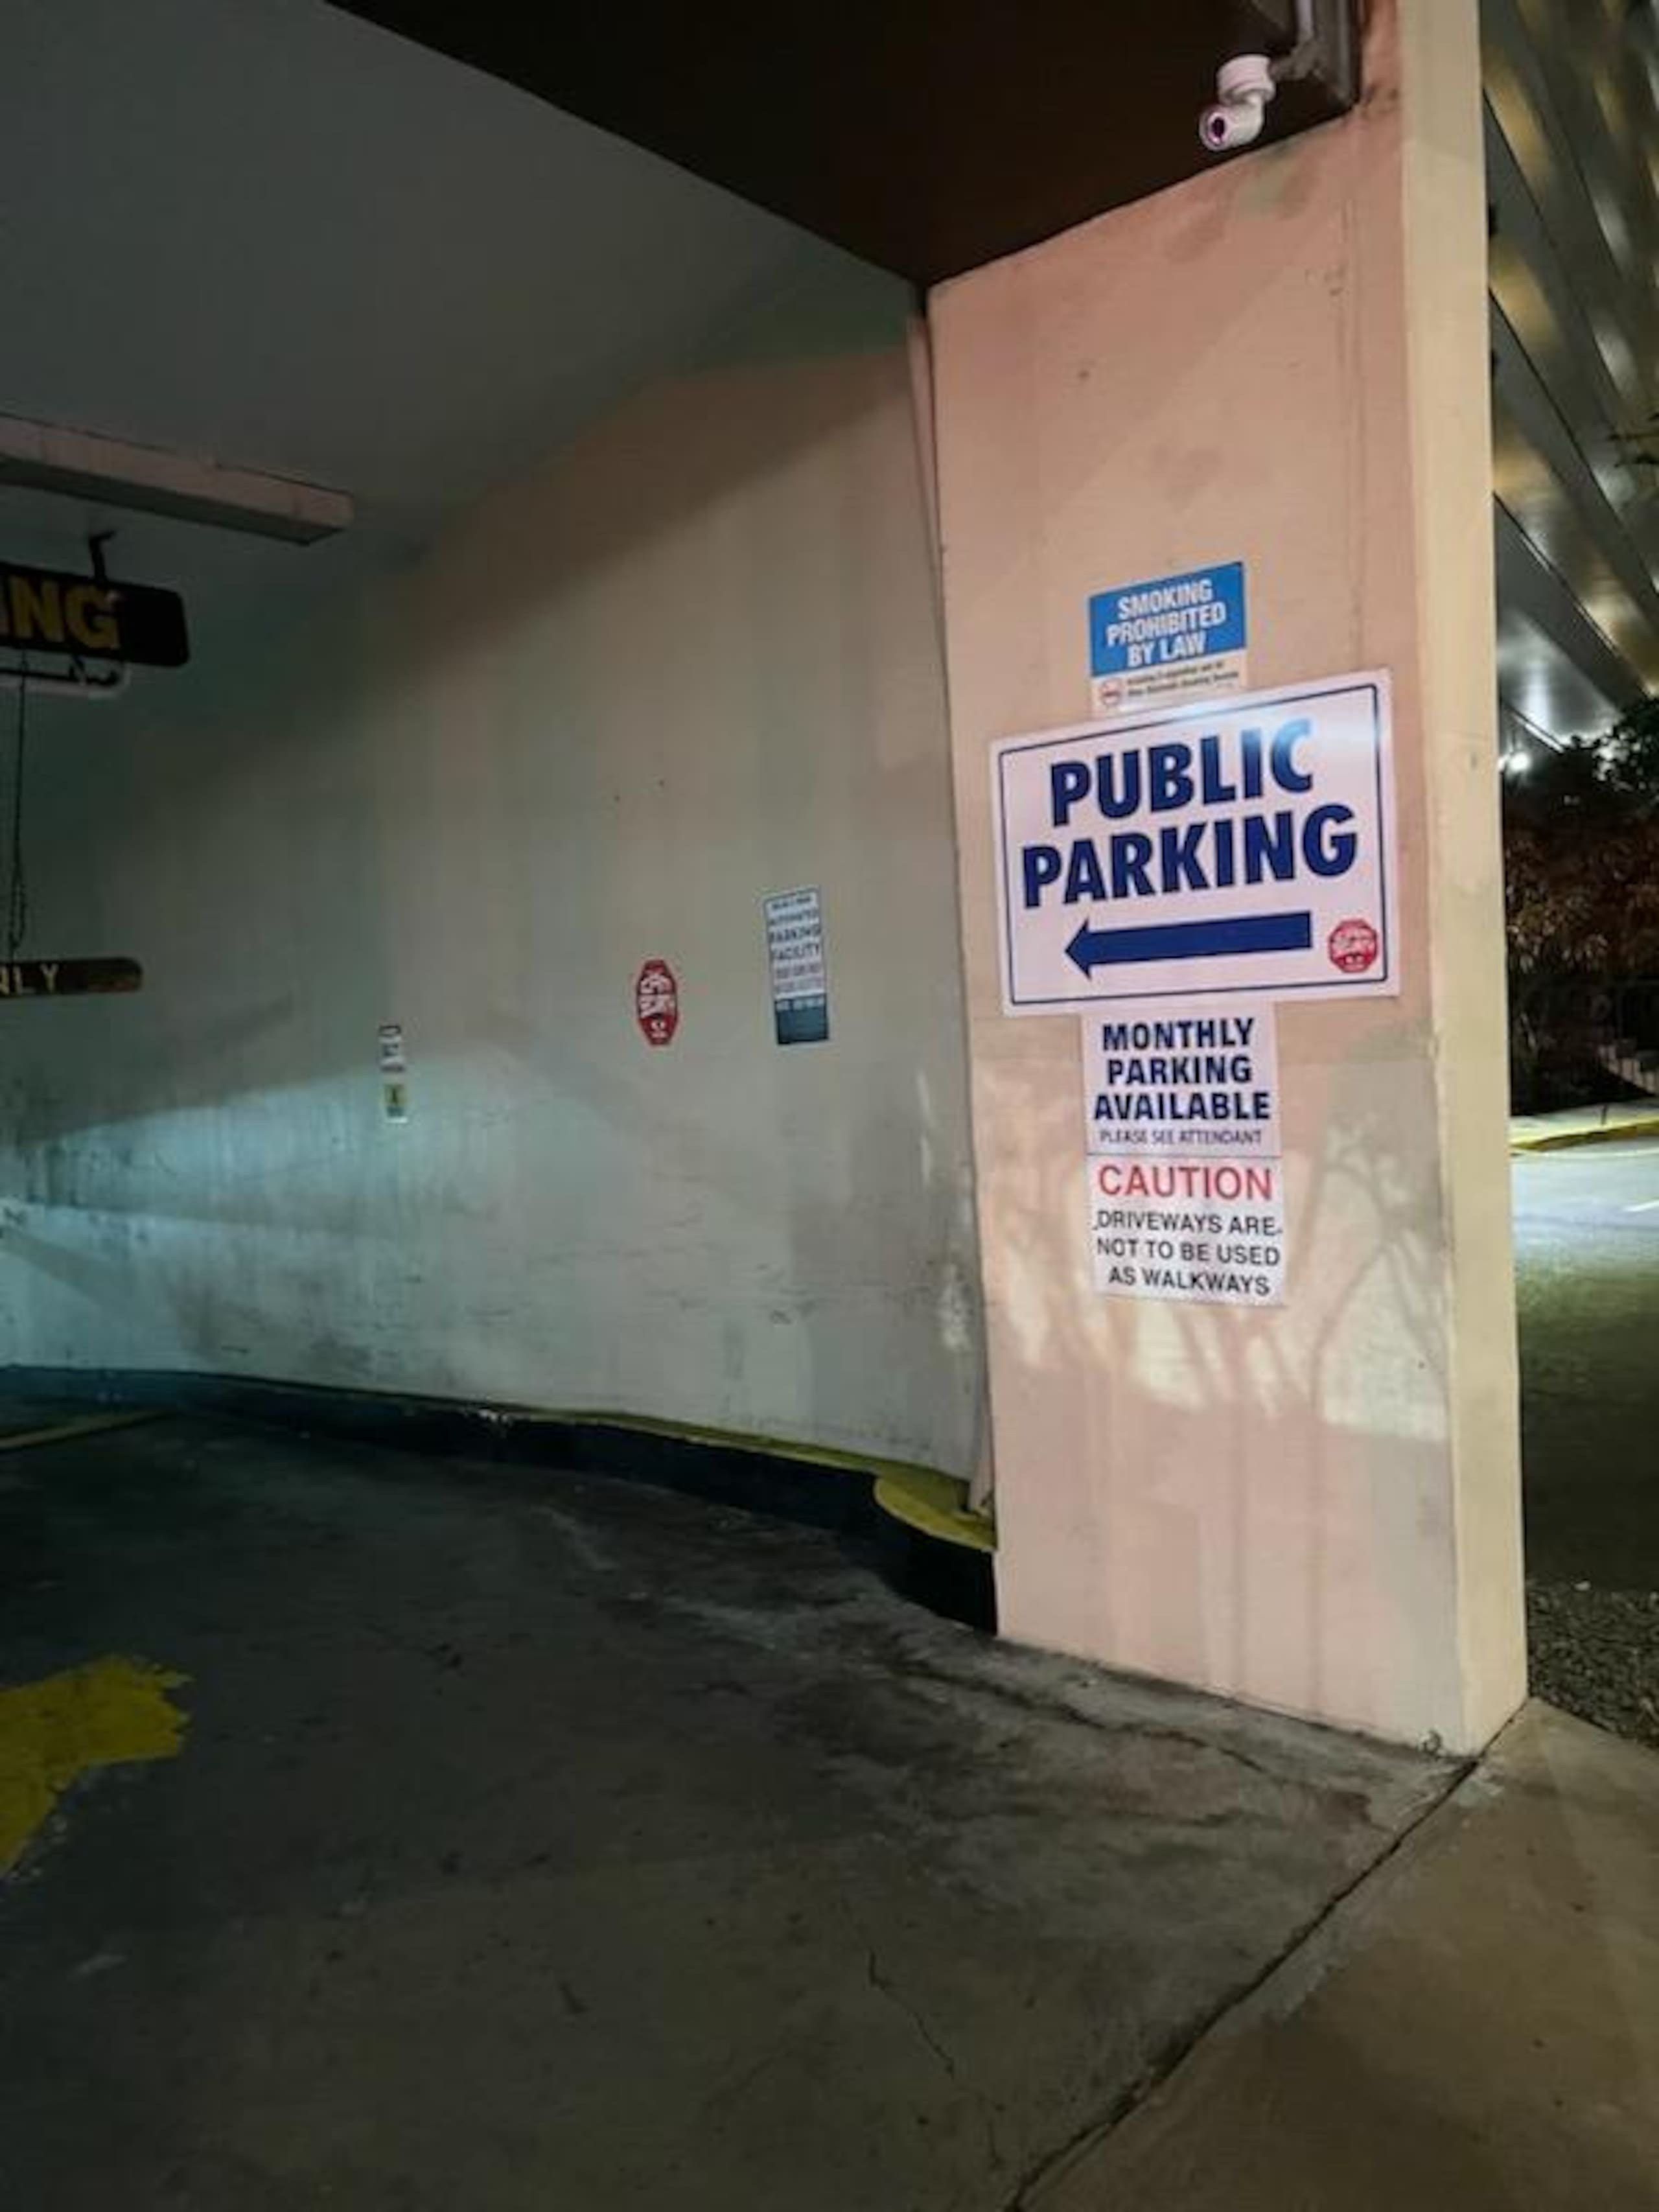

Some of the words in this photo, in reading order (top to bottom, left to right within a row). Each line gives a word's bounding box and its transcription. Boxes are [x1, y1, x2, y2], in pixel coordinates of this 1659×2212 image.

[1117, 578, 1213, 620] SMOKING
[1106, 601, 1227, 647] PROHIBITED
[1127, 643, 1155, 668] BY
[1159, 629, 1207, 661] LAW
[1050, 718, 1314, 827] PUBLIC
[1022, 804, 1358, 909] PARKING
[770, 923, 822, 942] PARKING
[772, 942, 820, 960] FACILITY
[1102, 1018, 1254, 1051] MONTHLY
[1107, 1054, 1253, 1086] PARKING
[1094, 1091, 1271, 1121] AVAILABLE
[1100, 1129, 1148, 1145] PLEASE
[1152, 1130, 1175, 1145] SEE
[1179, 1128, 1262, 1146] ATTENDANT
[1098, 1163, 1273, 1201] CAUTION
[1096, 1209, 1223, 1234] DRIVEWAYS
[1228, 1215, 1277, 1236] ARE
[1096, 1237, 1139, 1258] NOT
[1145, 1239, 1174, 1259] TO
[1180, 1242, 1210, 1262] BE
[1216, 1244, 1281, 1266] USED
[1108, 1266, 1136, 1286] AS
[1141, 1267, 1270, 1297] WALKWAYS
